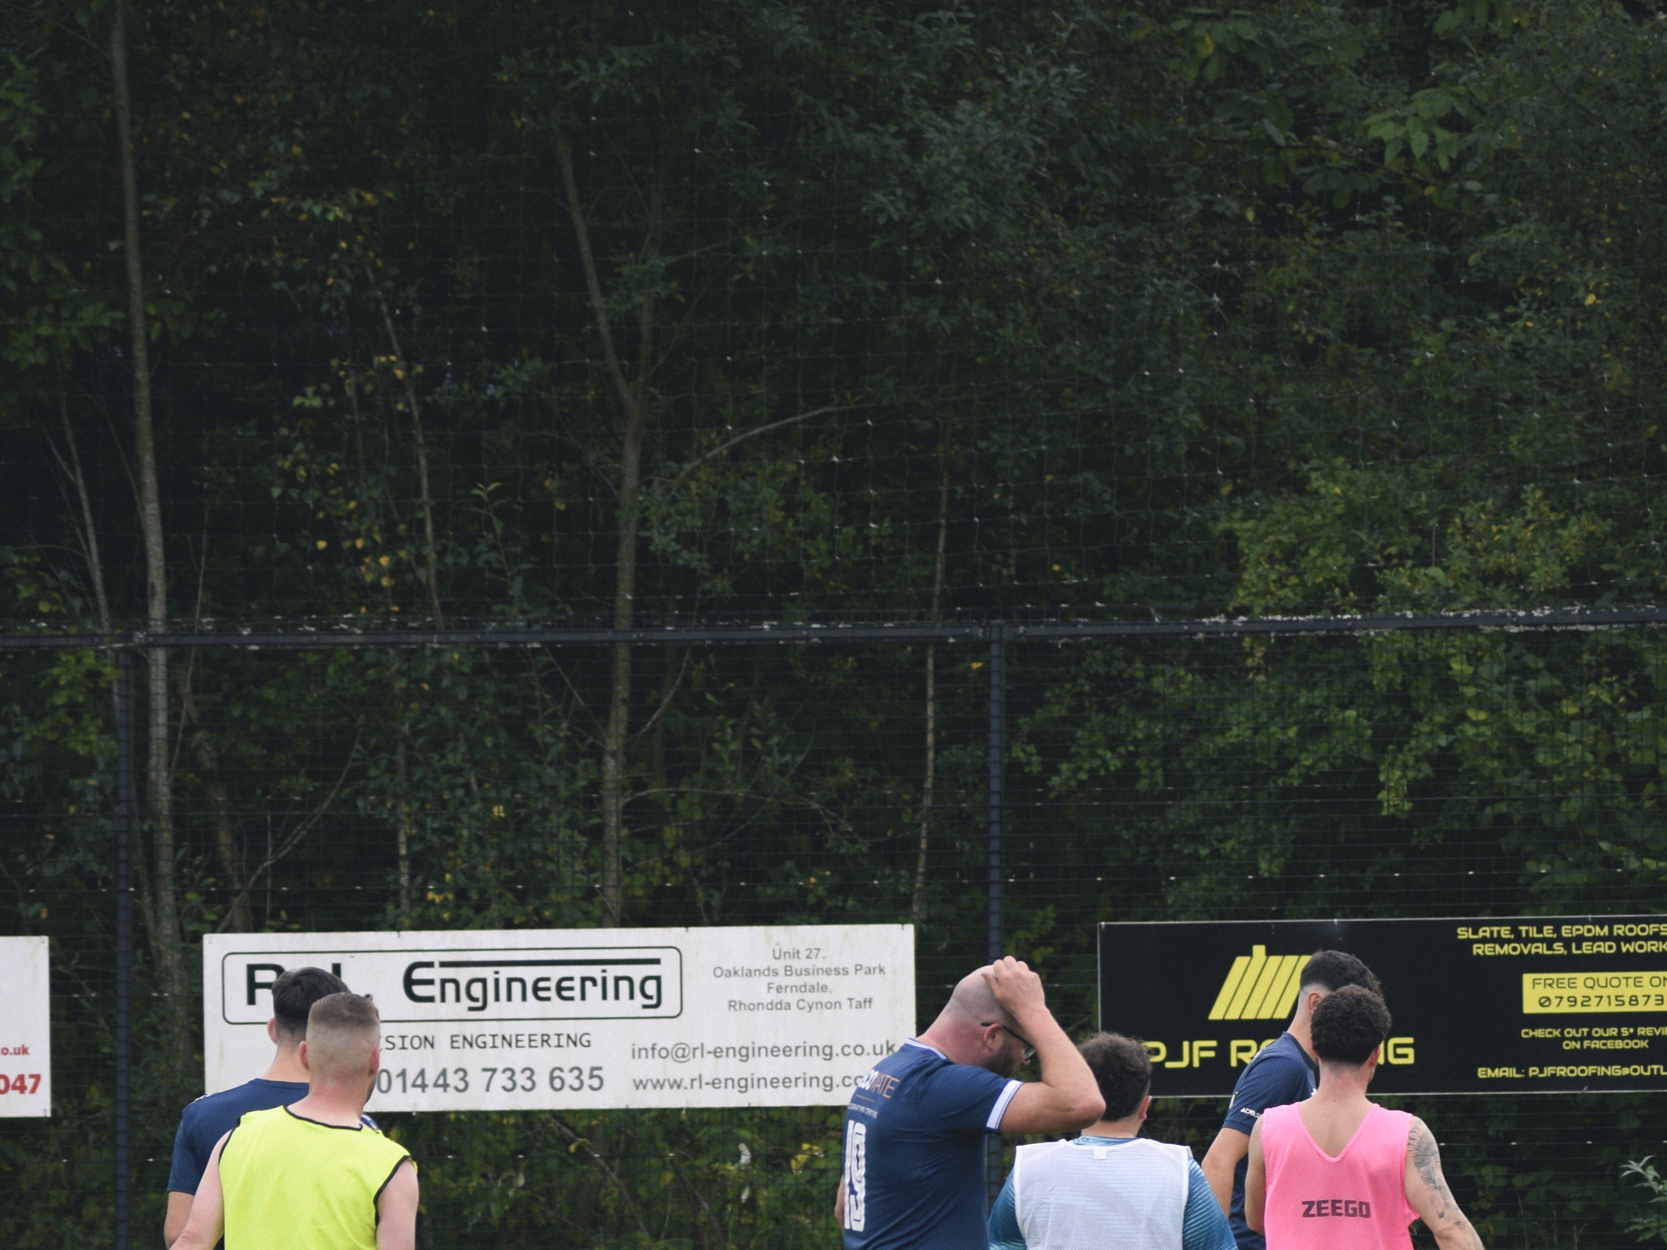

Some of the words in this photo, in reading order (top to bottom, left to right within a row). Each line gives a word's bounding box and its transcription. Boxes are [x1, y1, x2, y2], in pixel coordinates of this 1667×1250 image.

[1457, 926, 1514, 939] SLATE,
[1519, 925, 1557, 938] TILE,
[1561, 925, 1609, 937] EPDM
[772, 947, 801, 960] Unit
[1473, 942, 1567, 956] REMOVALS,
[1572, 942, 1616, 954] LEAD
[713, 966, 779, 978] Oaklands
[784, 964, 849, 977] Business
[854, 963, 886, 975] Park
[403, 958, 662, 1012] Engineering
[1532, 978, 1578, 989] FREE
[1583, 976, 1644, 990] QUOTE
[728, 999, 792, 1012] Rhondda
[797, 998, 842, 1014] Cynon
[847, 997, 873, 1010] Taff
[1538, 994, 1665, 1008] 0792715873
[1521, 1028, 1561, 1038] CHECK
[1564, 1028, 1589, 1037] OUT
[1592, 1027, 1618, 1037] OUR
[1637, 1026, 1667, 1036] REVI
[450, 1032, 592, 1049] ENGINEERING
[1562, 1041, 1580, 1050] ON
[1583, 1039, 1649, 1050] FACEBOOK
[631, 1040, 896, 1063] info@rl-engineering.co.uk
[1477, 1067, 1525, 1078] EMAIL:
[376, 1068, 469, 1094] 01443
[481, 1067, 536, 1093] 733
[549, 1066, 605, 1092] 635
